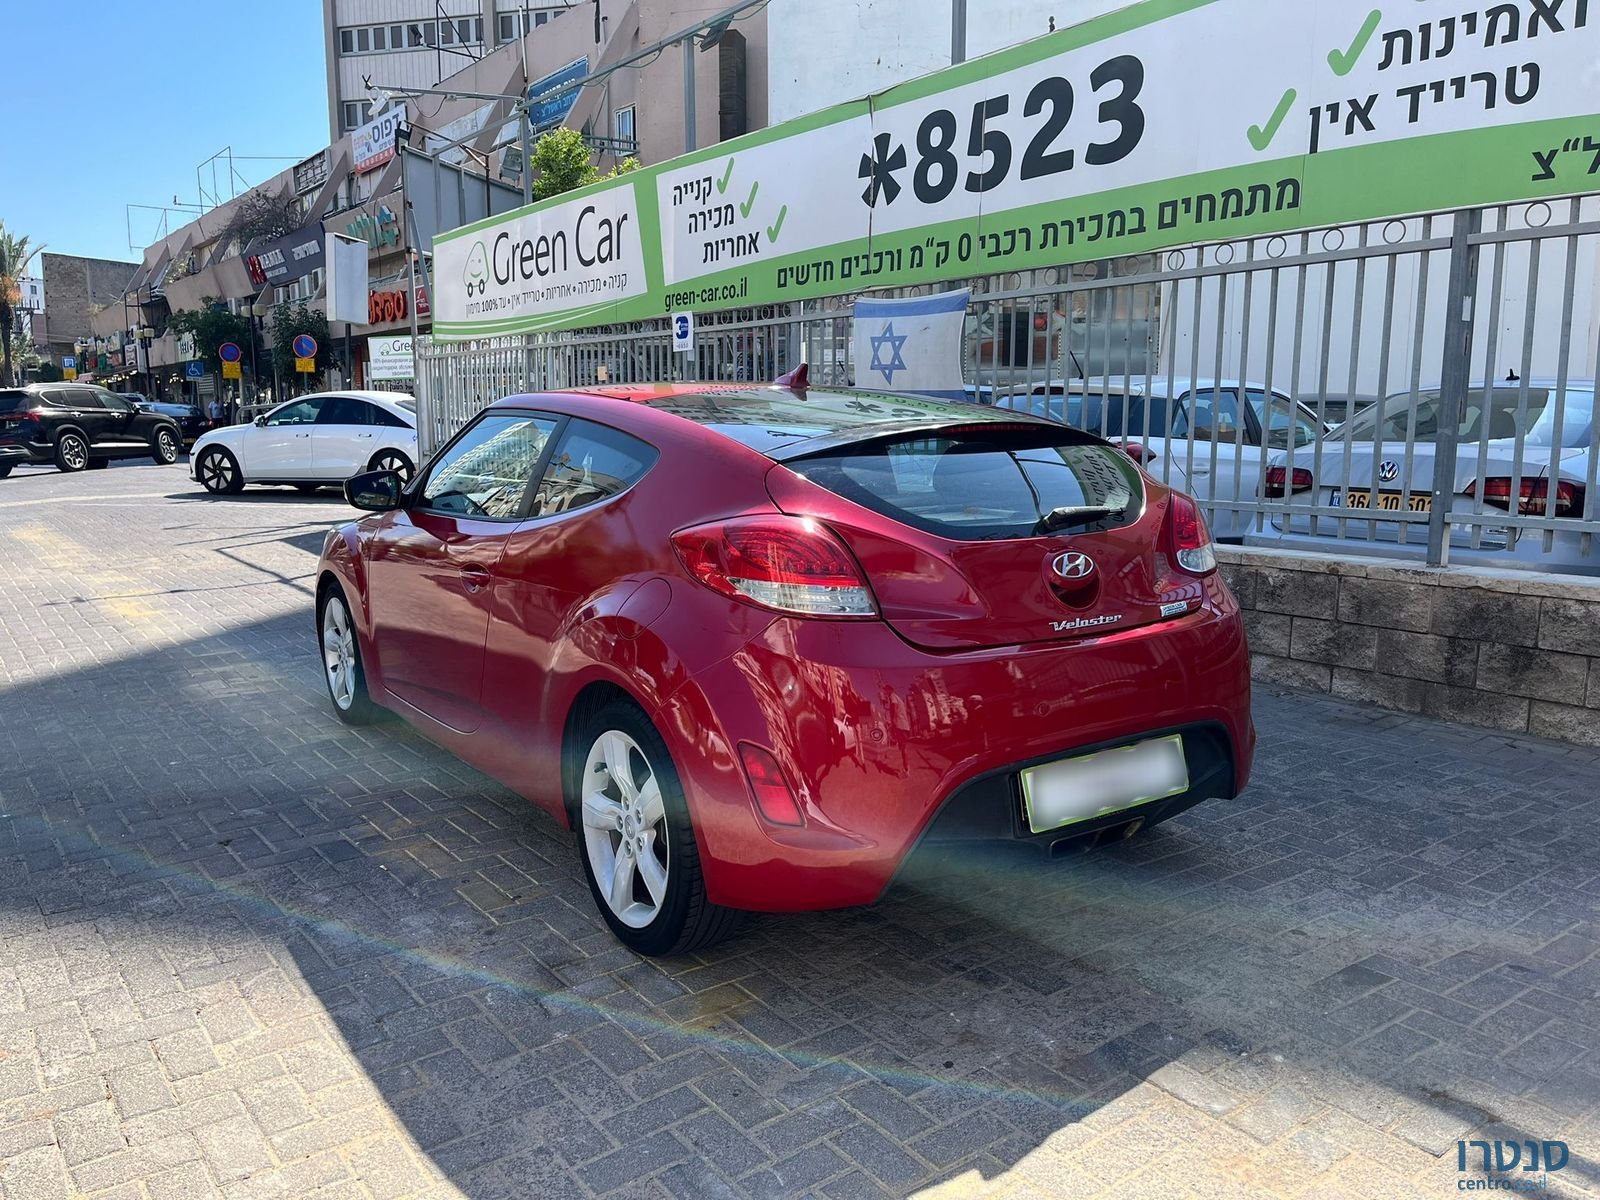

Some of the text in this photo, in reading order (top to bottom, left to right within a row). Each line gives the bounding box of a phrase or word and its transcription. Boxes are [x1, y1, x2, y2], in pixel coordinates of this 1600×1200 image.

[1309, 62, 1541, 154] טרייד אין
[673, 176, 712, 206] קנייה
[1158, 178, 1300, 230] מתמחים
[688, 203, 735, 234] מכירה
[1040, 206, 1146, 249] במכירת
[493, 205, 628, 286] Green Car
[702, 231, 760, 263] אחריות
[958, 233, 971, 262] 0
[979, 228, 1032, 258] רכבי
[777, 260, 834, 288] חדשים
[840, 248, 902, 279] ורכבים
[545, 284, 572, 300] אחריות
[578, 278, 601, 295] מכירה
[608, 273, 628, 291] קניה
[664, 276, 748, 312] green-car.co.il
[481, 299, 498, 312] 100%
[1049, 614, 1122, 632] Veloster
